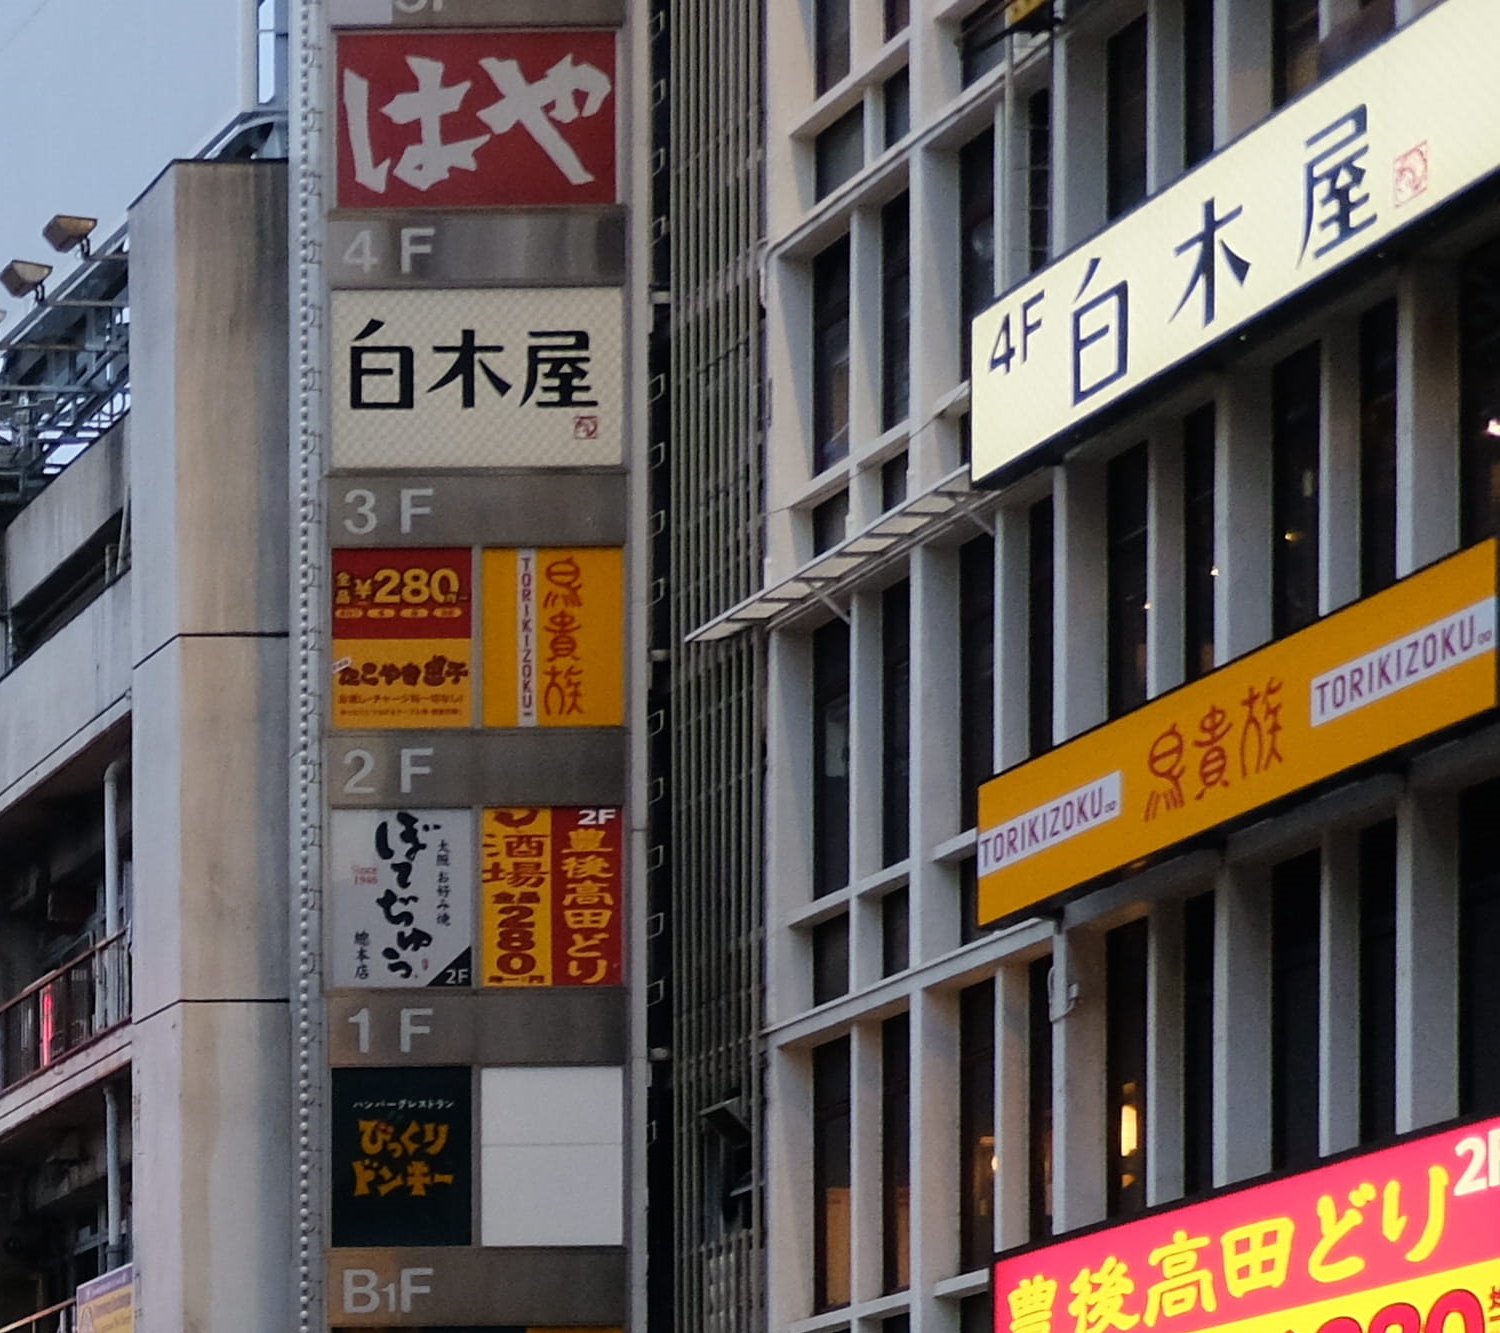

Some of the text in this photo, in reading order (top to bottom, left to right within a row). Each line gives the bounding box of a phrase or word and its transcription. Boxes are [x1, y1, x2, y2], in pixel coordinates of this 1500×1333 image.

[343, 53, 612, 193] はや
[1067, 103, 1379, 408] 白木屋
[348, 318, 599, 410] 白木屋
[987, 289, 1046, 375] 4F
[522, 557, 533, 706] TORIKIZOKU
[1315, 613, 1476, 717] TORIKIZOKU
[577, 808, 616, 825] 2F
[980, 786, 1103, 868] TORIKIZOKU
[374, 812, 441, 980] ぼてぢゅう
[436, 870, 451, 927] お好み焼
[482, 833, 549, 974] 酒場 280
[561, 828, 614, 984] 豊後高田どり
[445, 969, 469, 985] 2F
[352, 1159, 454, 1197] ドンキー
[357, 1118, 449, 1158] びっくり
[342, 1266, 434, 1314] B1F
